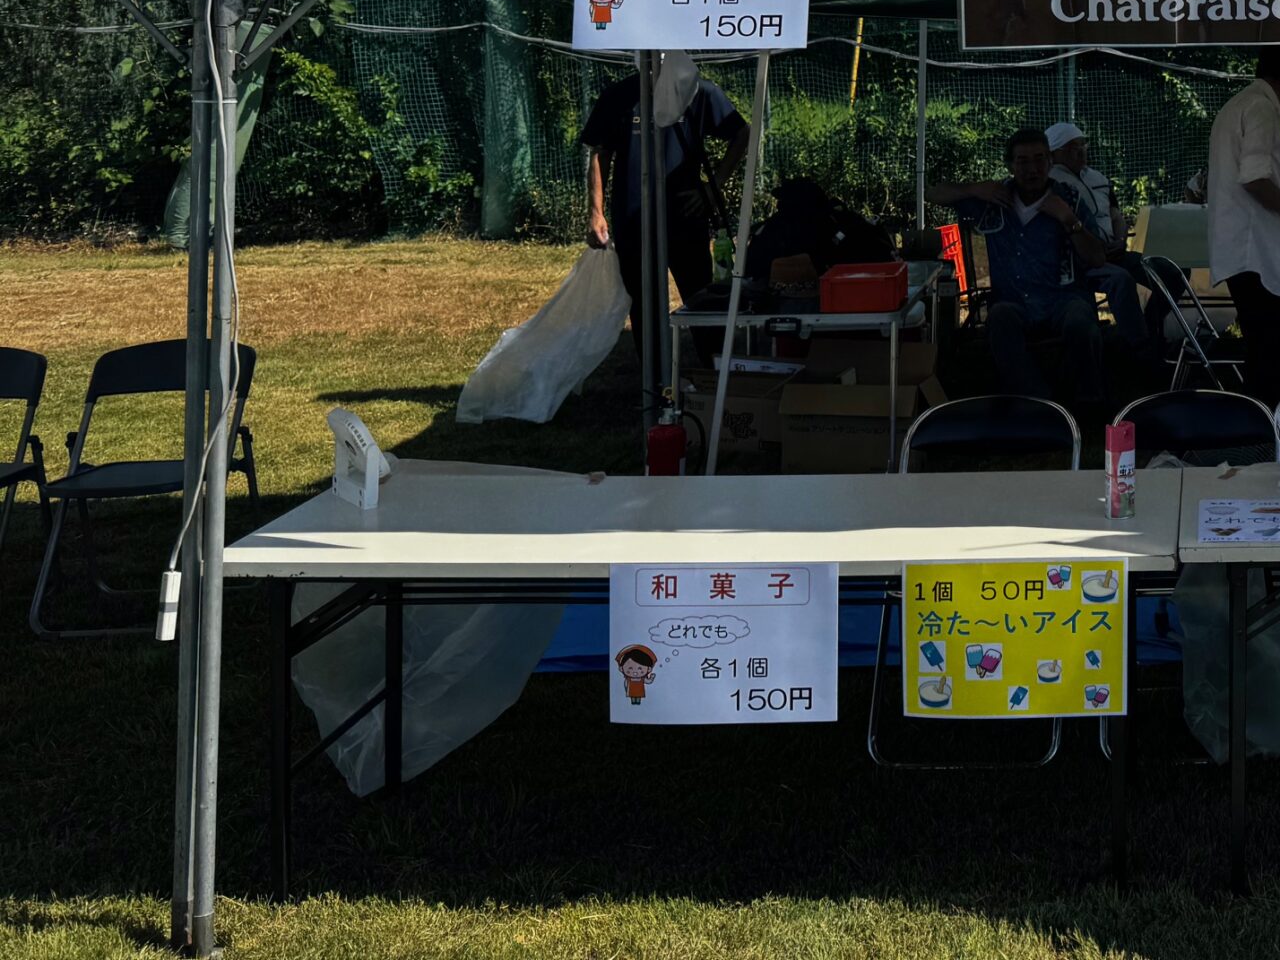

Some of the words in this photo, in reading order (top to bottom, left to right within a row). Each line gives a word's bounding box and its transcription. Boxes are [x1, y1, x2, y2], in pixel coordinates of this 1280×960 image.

[700, 15, 783, 37] 150円
[651, 572, 794, 600] 和菓子
[914, 581, 953, 602] 1個
[981, 580, 1044, 601] 50円
[668, 624, 728, 639] どれでも
[700, 657, 768, 679] 各1個
[730, 687, 813, 711] 150円
